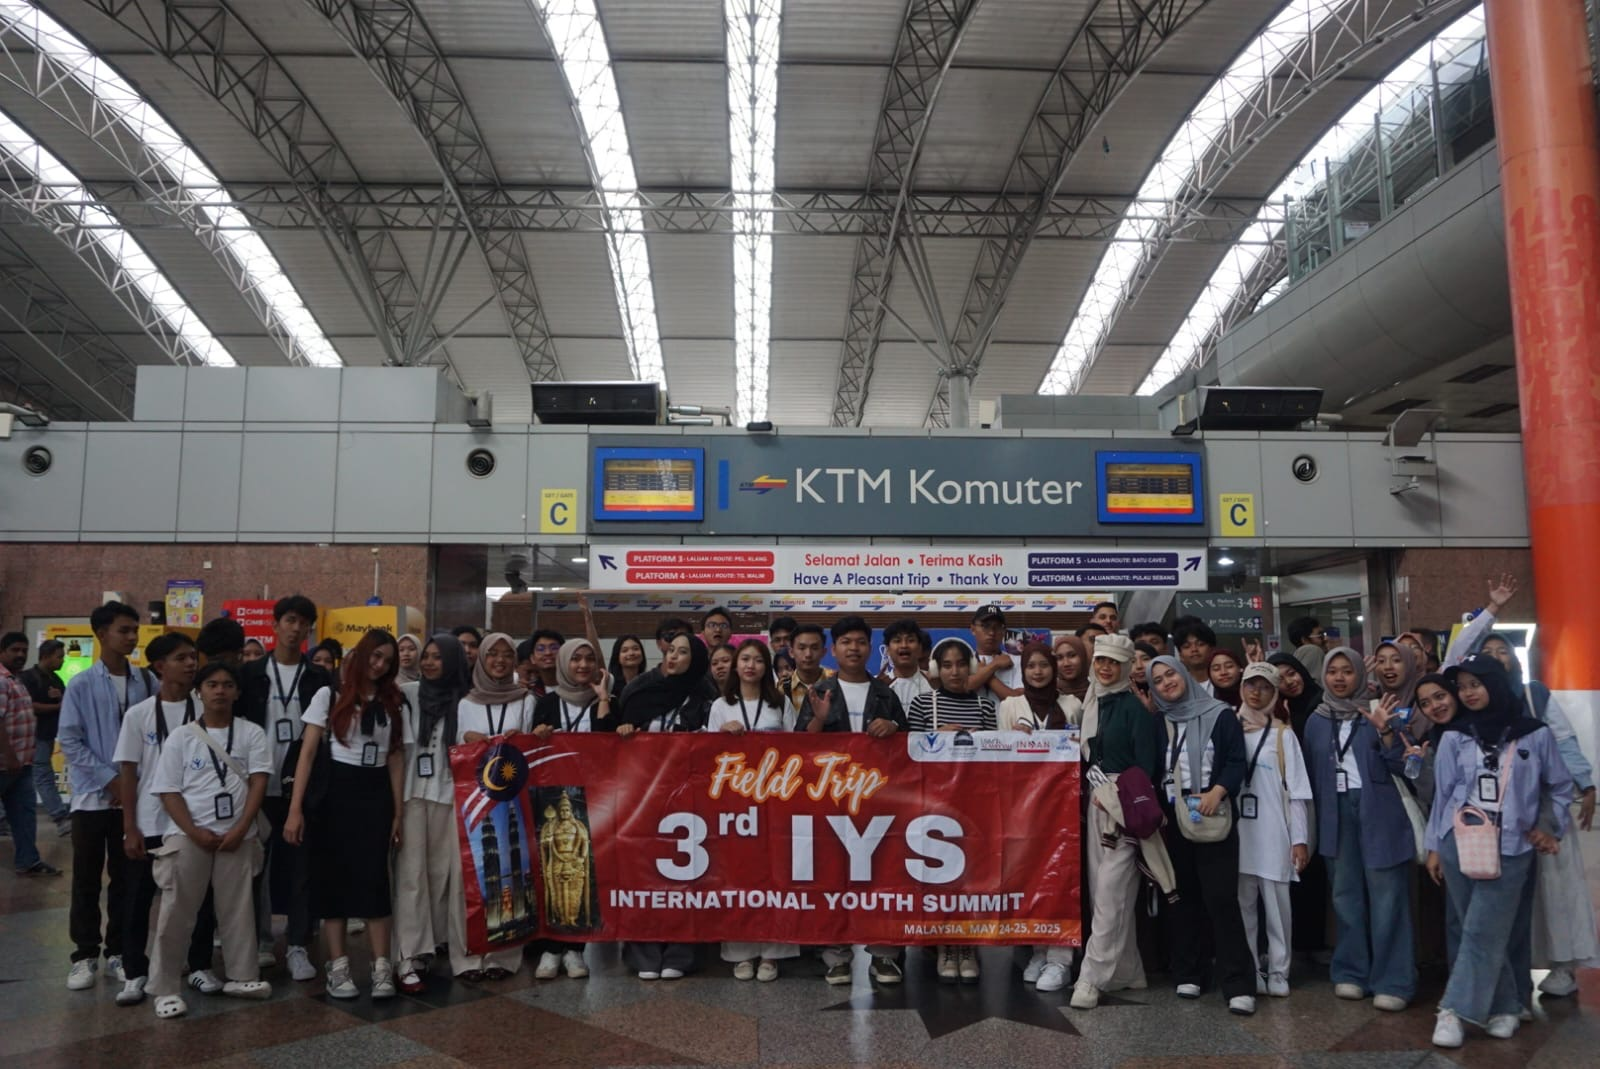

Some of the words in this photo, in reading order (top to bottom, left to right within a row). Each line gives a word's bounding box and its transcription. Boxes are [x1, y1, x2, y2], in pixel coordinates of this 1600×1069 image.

[796, 468, 892, 504] KTM
[909, 468, 1082, 505] Komuter
[550, 502, 568, 526] C
[1230, 504, 1248, 526] C
[804, 552, 860, 566] Selamat
[864, 552, 900, 566] Jalan
[920, 553, 964, 567] Terima
[968, 553, 1004, 567] Kasih
[794, 572, 828, 585] Have
[833, 572, 842, 585] A
[847, 572, 904, 585] Pleasant
[906, 573, 930, 588] Trip
[950, 572, 990, 586] Thank
[992, 572, 1018, 586] You
[711, 748, 802, 801] Field
[807, 752, 888, 815] Trip
[656, 806, 758, 882] 3rd
[792, 814, 966, 884] IYS
[610, 890, 816, 910] INTERNATIONAL
[824, 892, 914, 912] YOUTH
[922, 892, 1025, 912] SUMMIT
[904, 923, 966, 936] MALAYSIA,
[970, 923, 996, 936] MAY
[999, 923, 1030, 936] 24-25,
[1033, 923, 1061, 935] 2025
